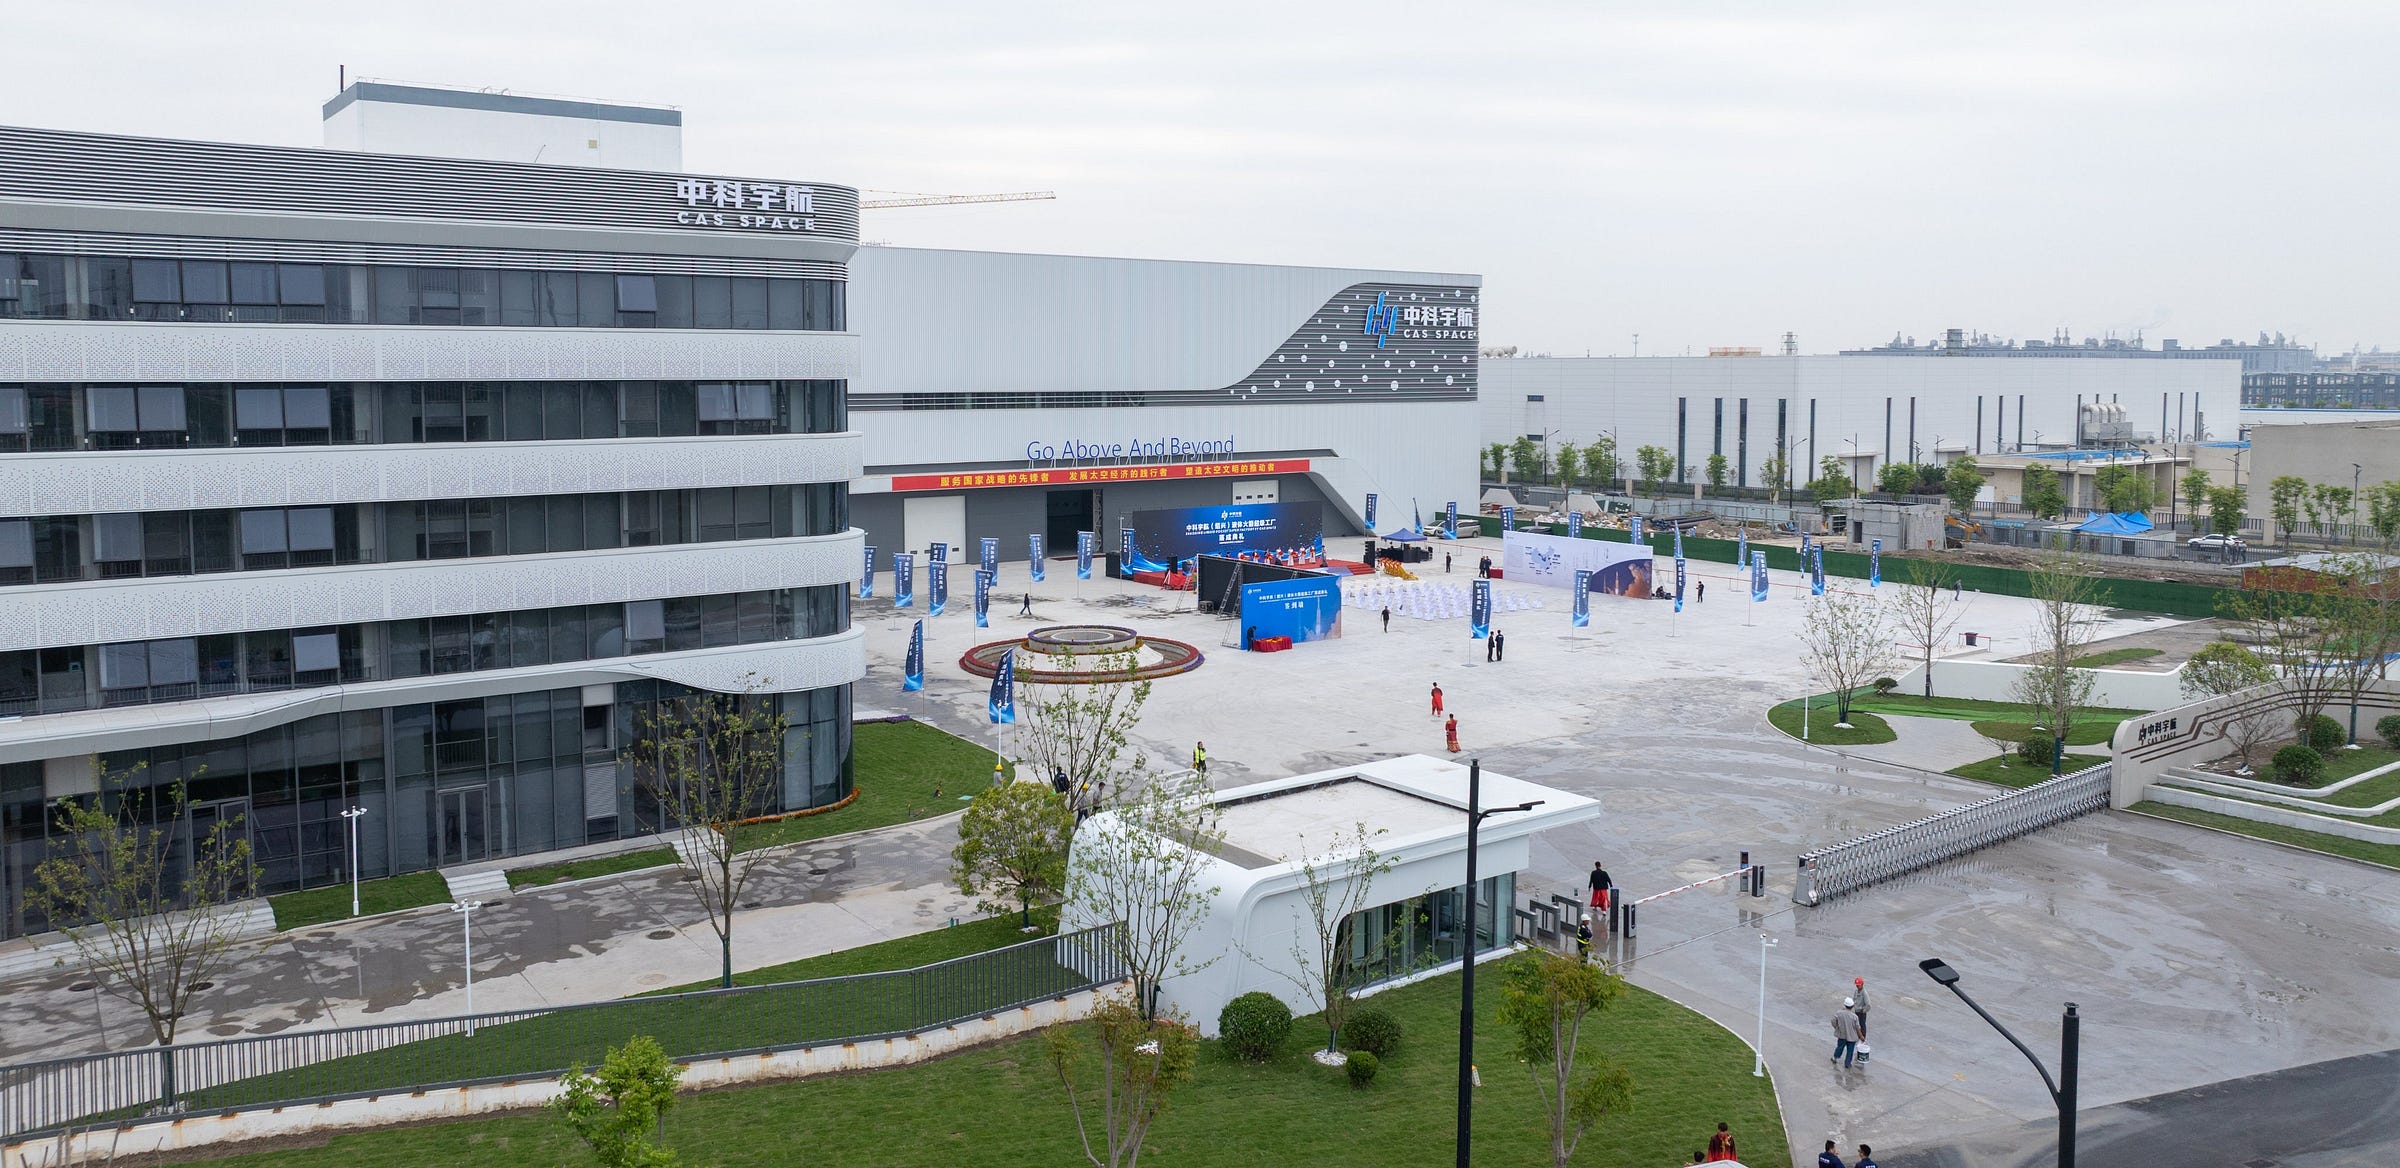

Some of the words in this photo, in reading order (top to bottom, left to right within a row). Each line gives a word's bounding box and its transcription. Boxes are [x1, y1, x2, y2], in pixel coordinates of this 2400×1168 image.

[676, 177, 815, 213] 中科宇航
[677, 211, 725, 226] CAS
[739, 214, 816, 231] SPACE
[1403, 306, 1474, 327] 中科宇航
[1403, 329, 1428, 339] CAS
[1435, 330, 1474, 340] SPACE
[1027, 440, 1055, 461] Go
[1061, 439, 1122, 460] Above
[1129, 437, 1165, 457] And
[1170, 434, 1234, 460] Beyond
[940, 472, 1050, 487] 服务国家战略的先锋者
[1068, 467, 1168, 481] 发展太空经济的践行者
[1185, 462, 1276, 476] 塑造太空文明的推动者
[2147, 717, 2177, 736] 中科宇航
